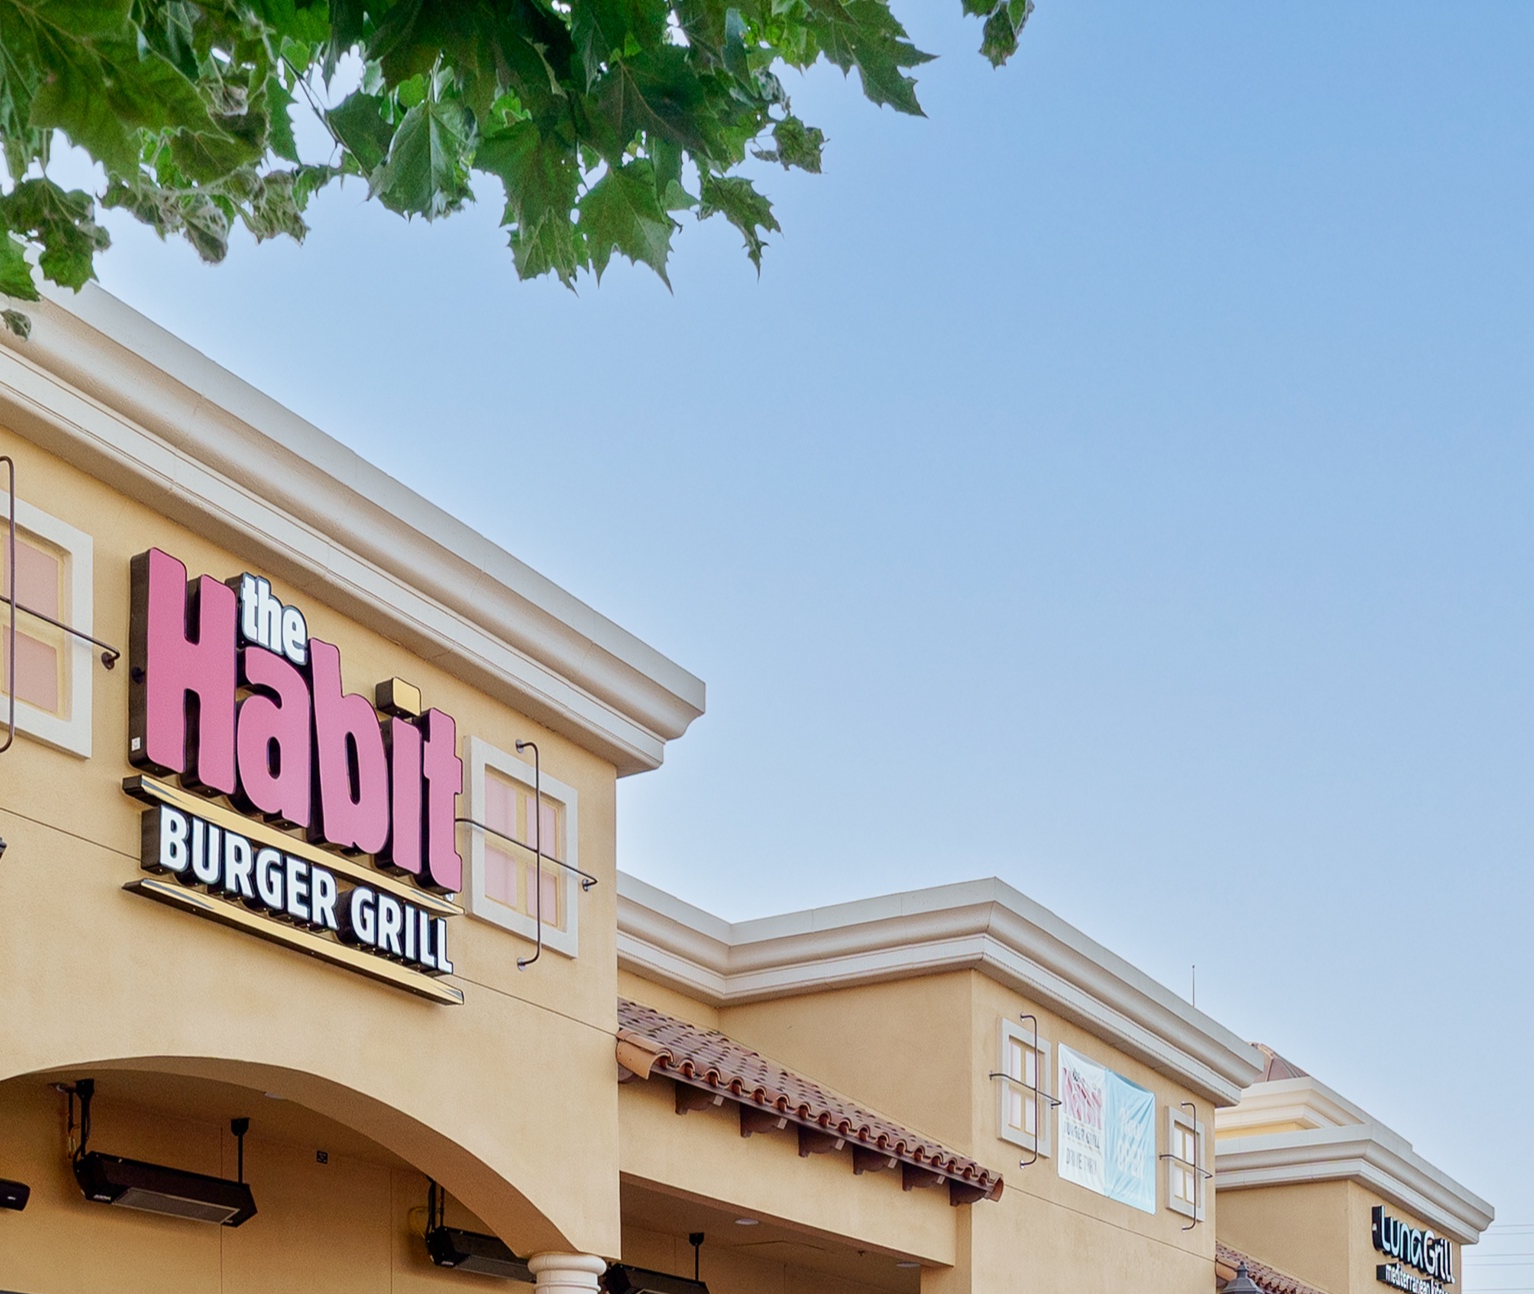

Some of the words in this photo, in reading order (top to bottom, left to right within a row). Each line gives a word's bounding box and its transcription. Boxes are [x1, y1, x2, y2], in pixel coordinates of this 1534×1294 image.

[240, 571, 308, 665] the
[145, 546, 463, 894] Habit
[158, 804, 339, 931] BURGER
[350, 886, 454, 975] GRILL
